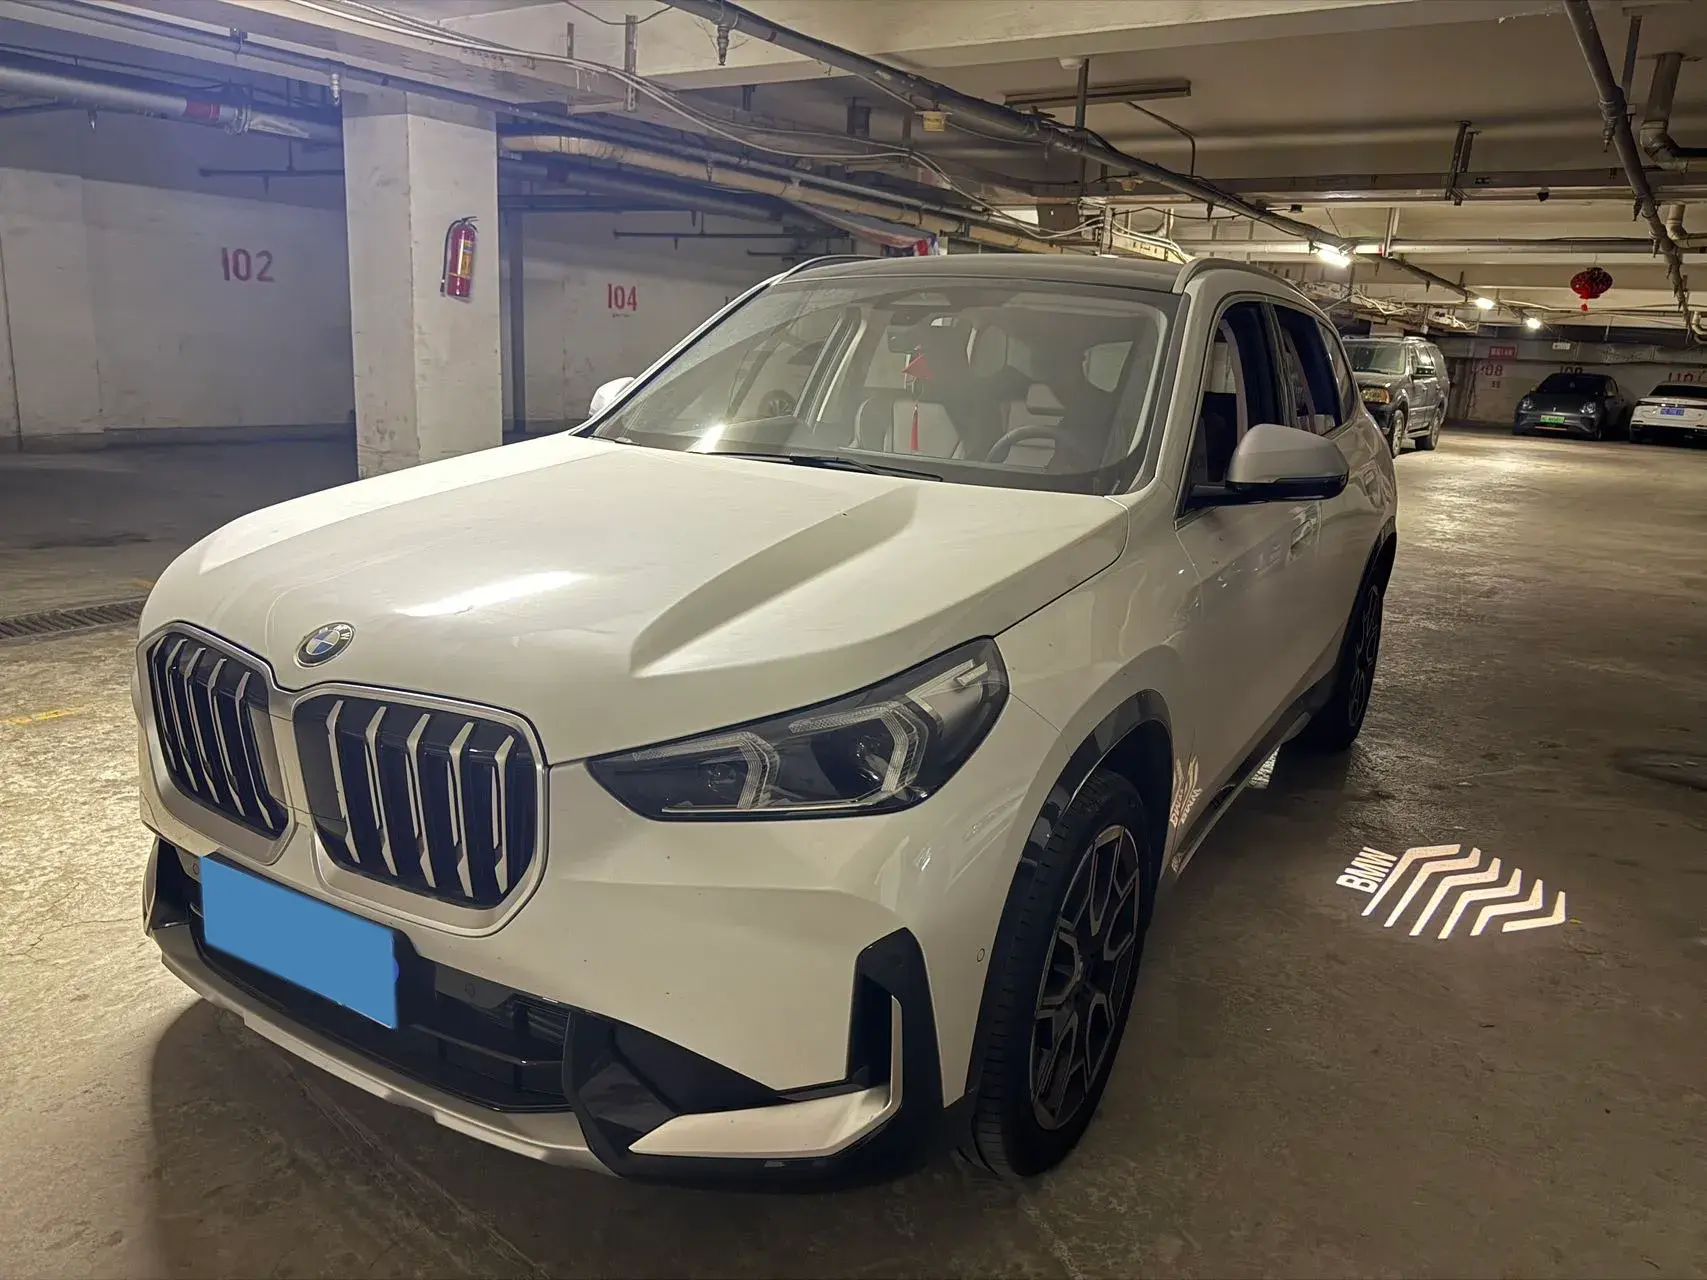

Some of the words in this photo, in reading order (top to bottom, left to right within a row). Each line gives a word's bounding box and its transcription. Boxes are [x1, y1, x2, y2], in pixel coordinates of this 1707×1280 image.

[221, 247, 276, 282] 102
[608, 283, 637, 311] 104
[1336, 846, 1398, 893] BMW
